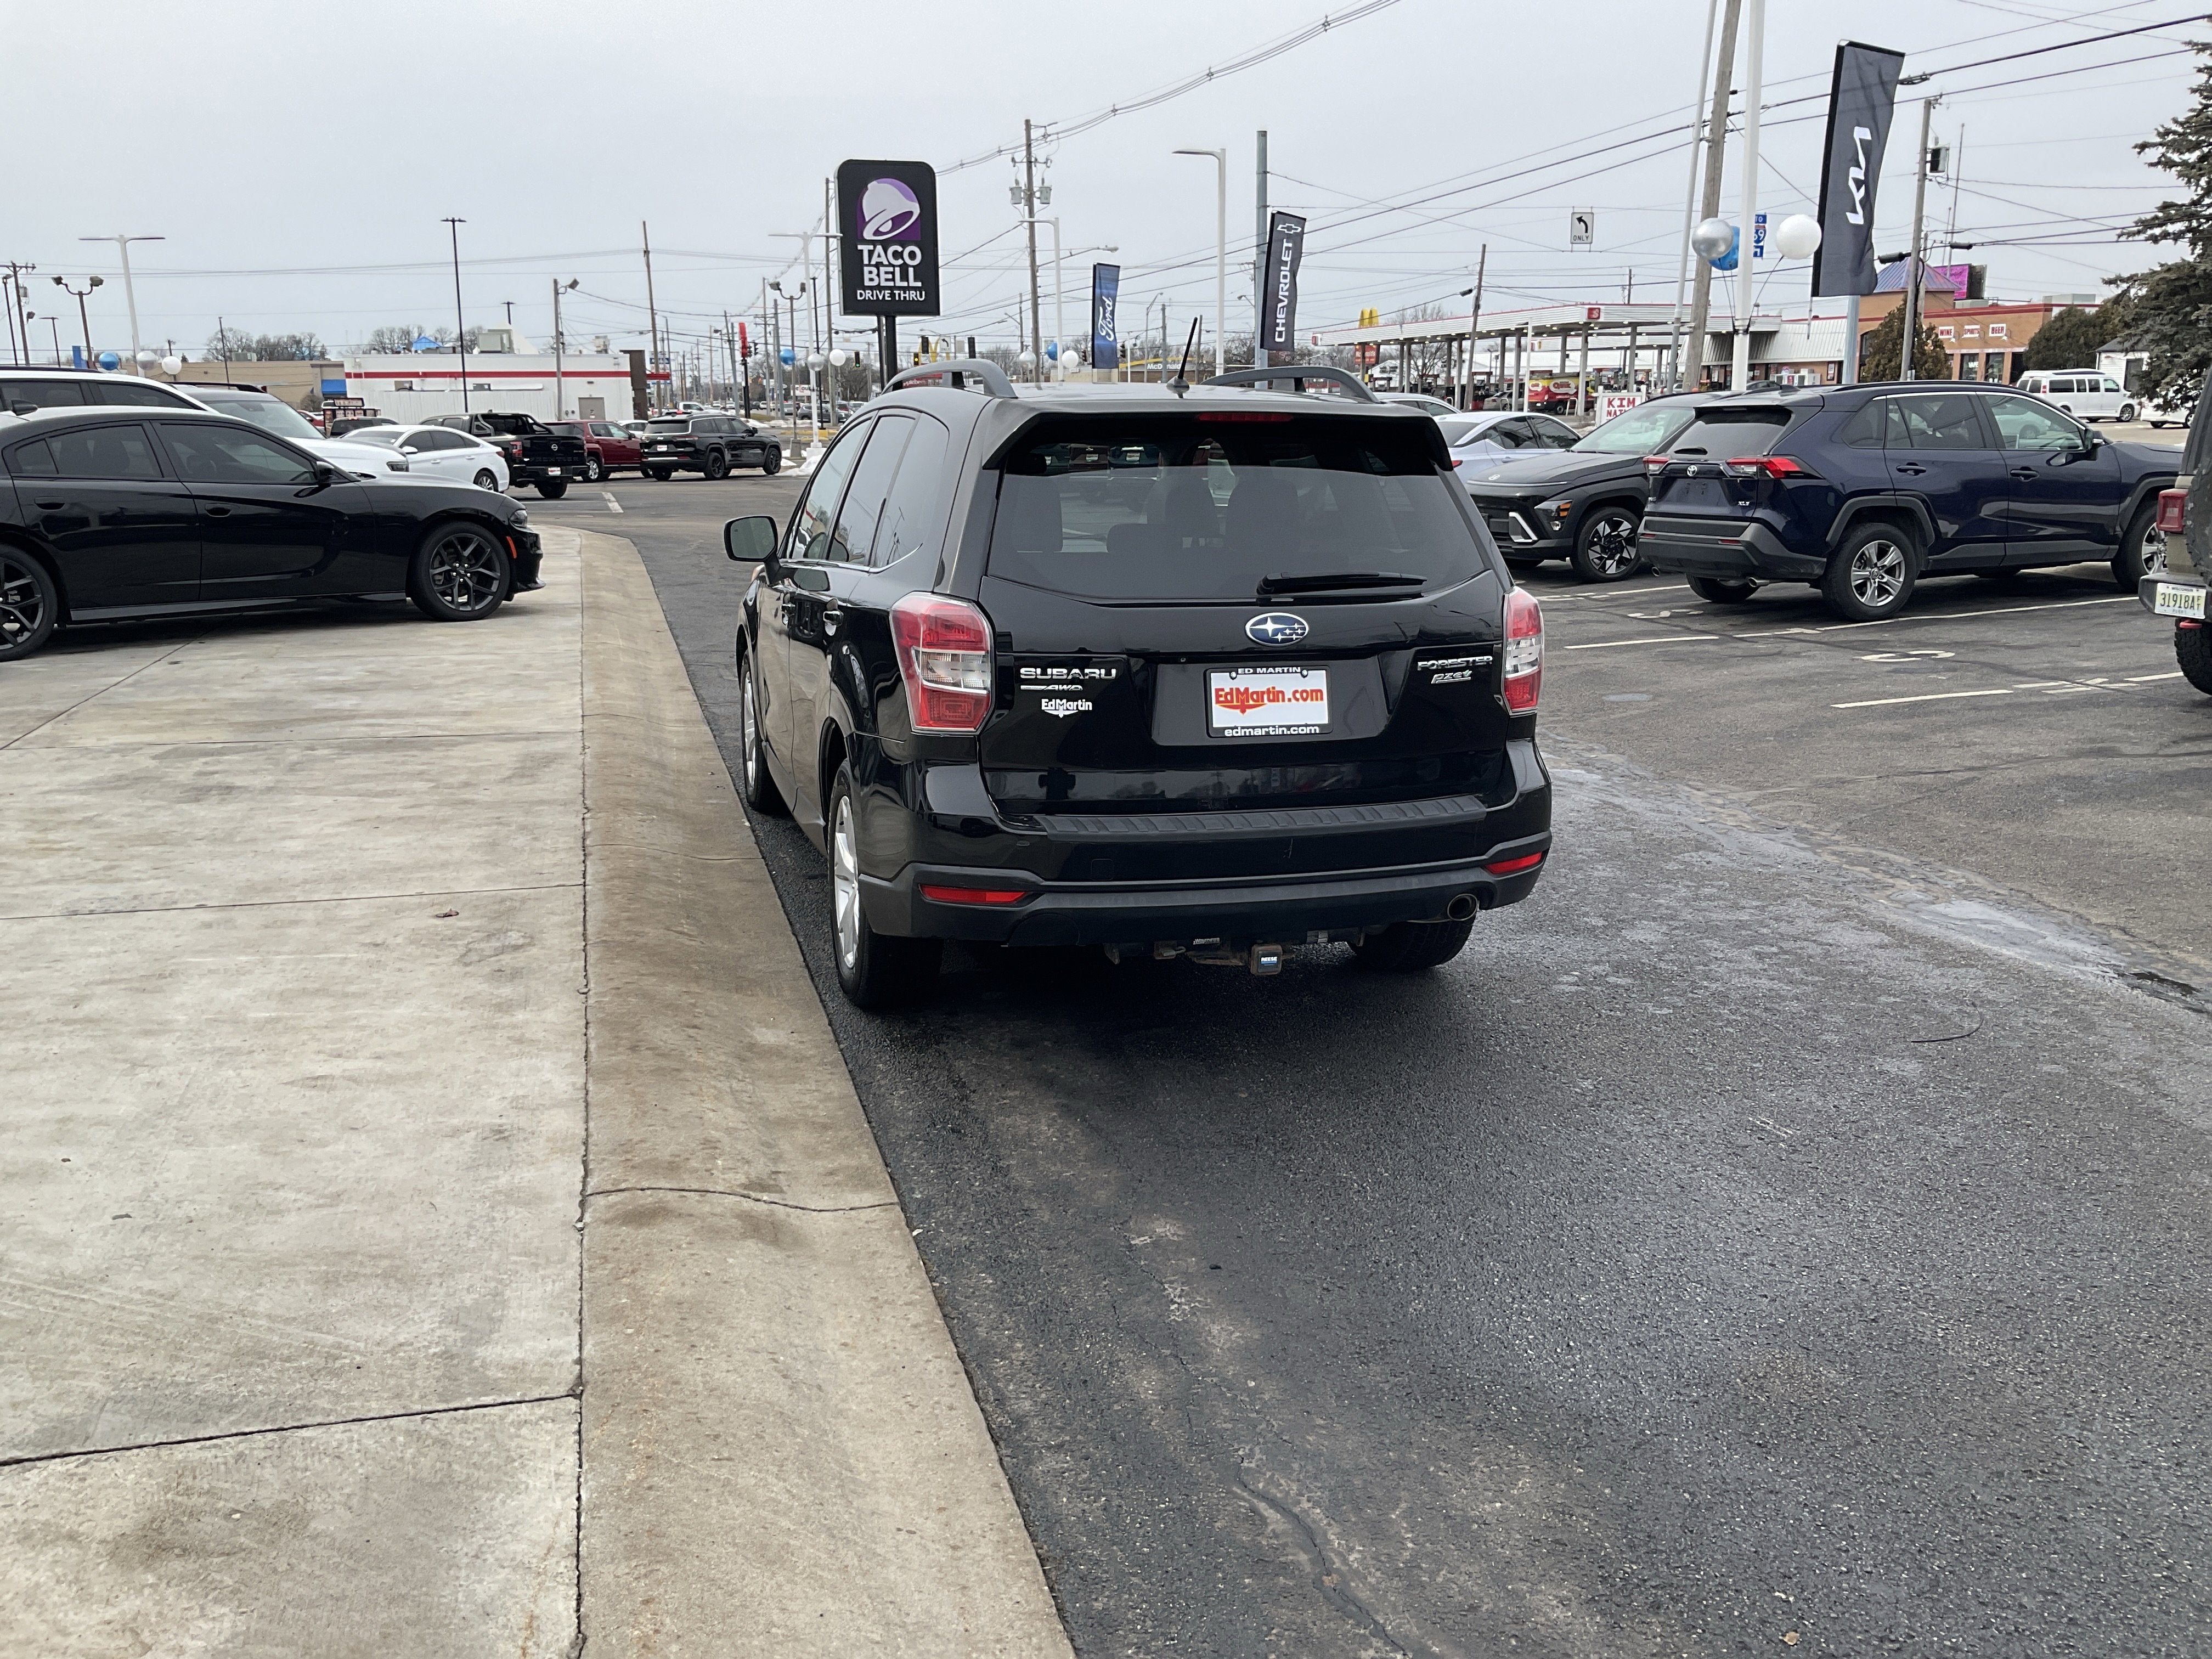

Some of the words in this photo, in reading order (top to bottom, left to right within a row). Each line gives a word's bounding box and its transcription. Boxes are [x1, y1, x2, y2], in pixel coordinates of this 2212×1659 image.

[1846, 126, 1872, 225] KIA
[857, 245, 922, 266] TACO
[863, 266, 922, 287] BELL
[856, 290, 891, 300] DRIVE
[893, 290, 926, 301] THRU
[1274, 239, 1293, 342] CHEVROLET
[1098, 296, 1114, 341] Ford
[1990, 326, 2005, 334] BEER
[1607, 397, 1635, 408] KIM
[1417, 656, 1493, 671] FORESTER
[1020, 667, 1116, 679] SUBARU
[1041, 698, 1093, 710] EdMartin
[1224, 725, 1319, 737] edmartin.com
